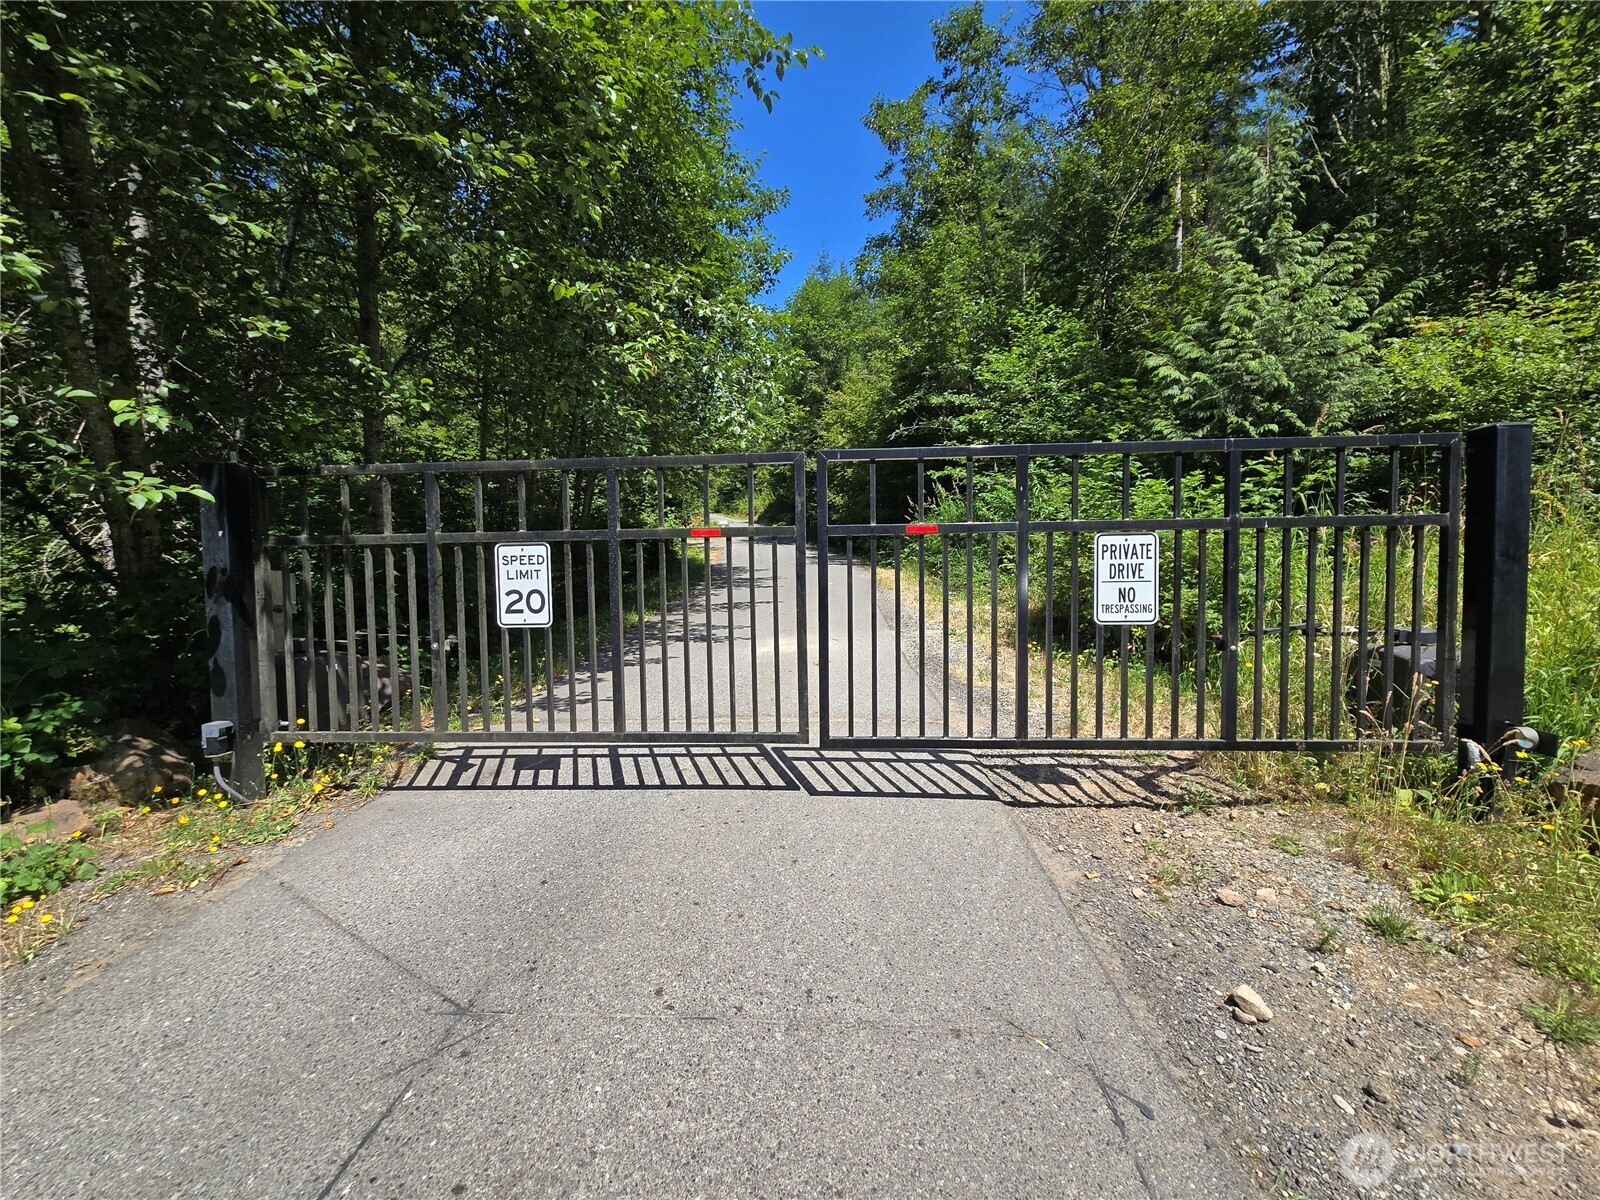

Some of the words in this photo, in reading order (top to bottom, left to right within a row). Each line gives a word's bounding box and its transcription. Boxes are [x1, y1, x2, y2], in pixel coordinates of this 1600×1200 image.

[501, 554, 545, 566] SPEED
[1101, 543, 1153, 560] PRIVATE
[506, 569, 541, 580] LIMIT
[1109, 562, 1145, 580] DRIVE
[504, 588, 546, 615] 20
[1118, 586, 1136, 603] NO
[1101, 603, 1153, 614] TRESPASSING
